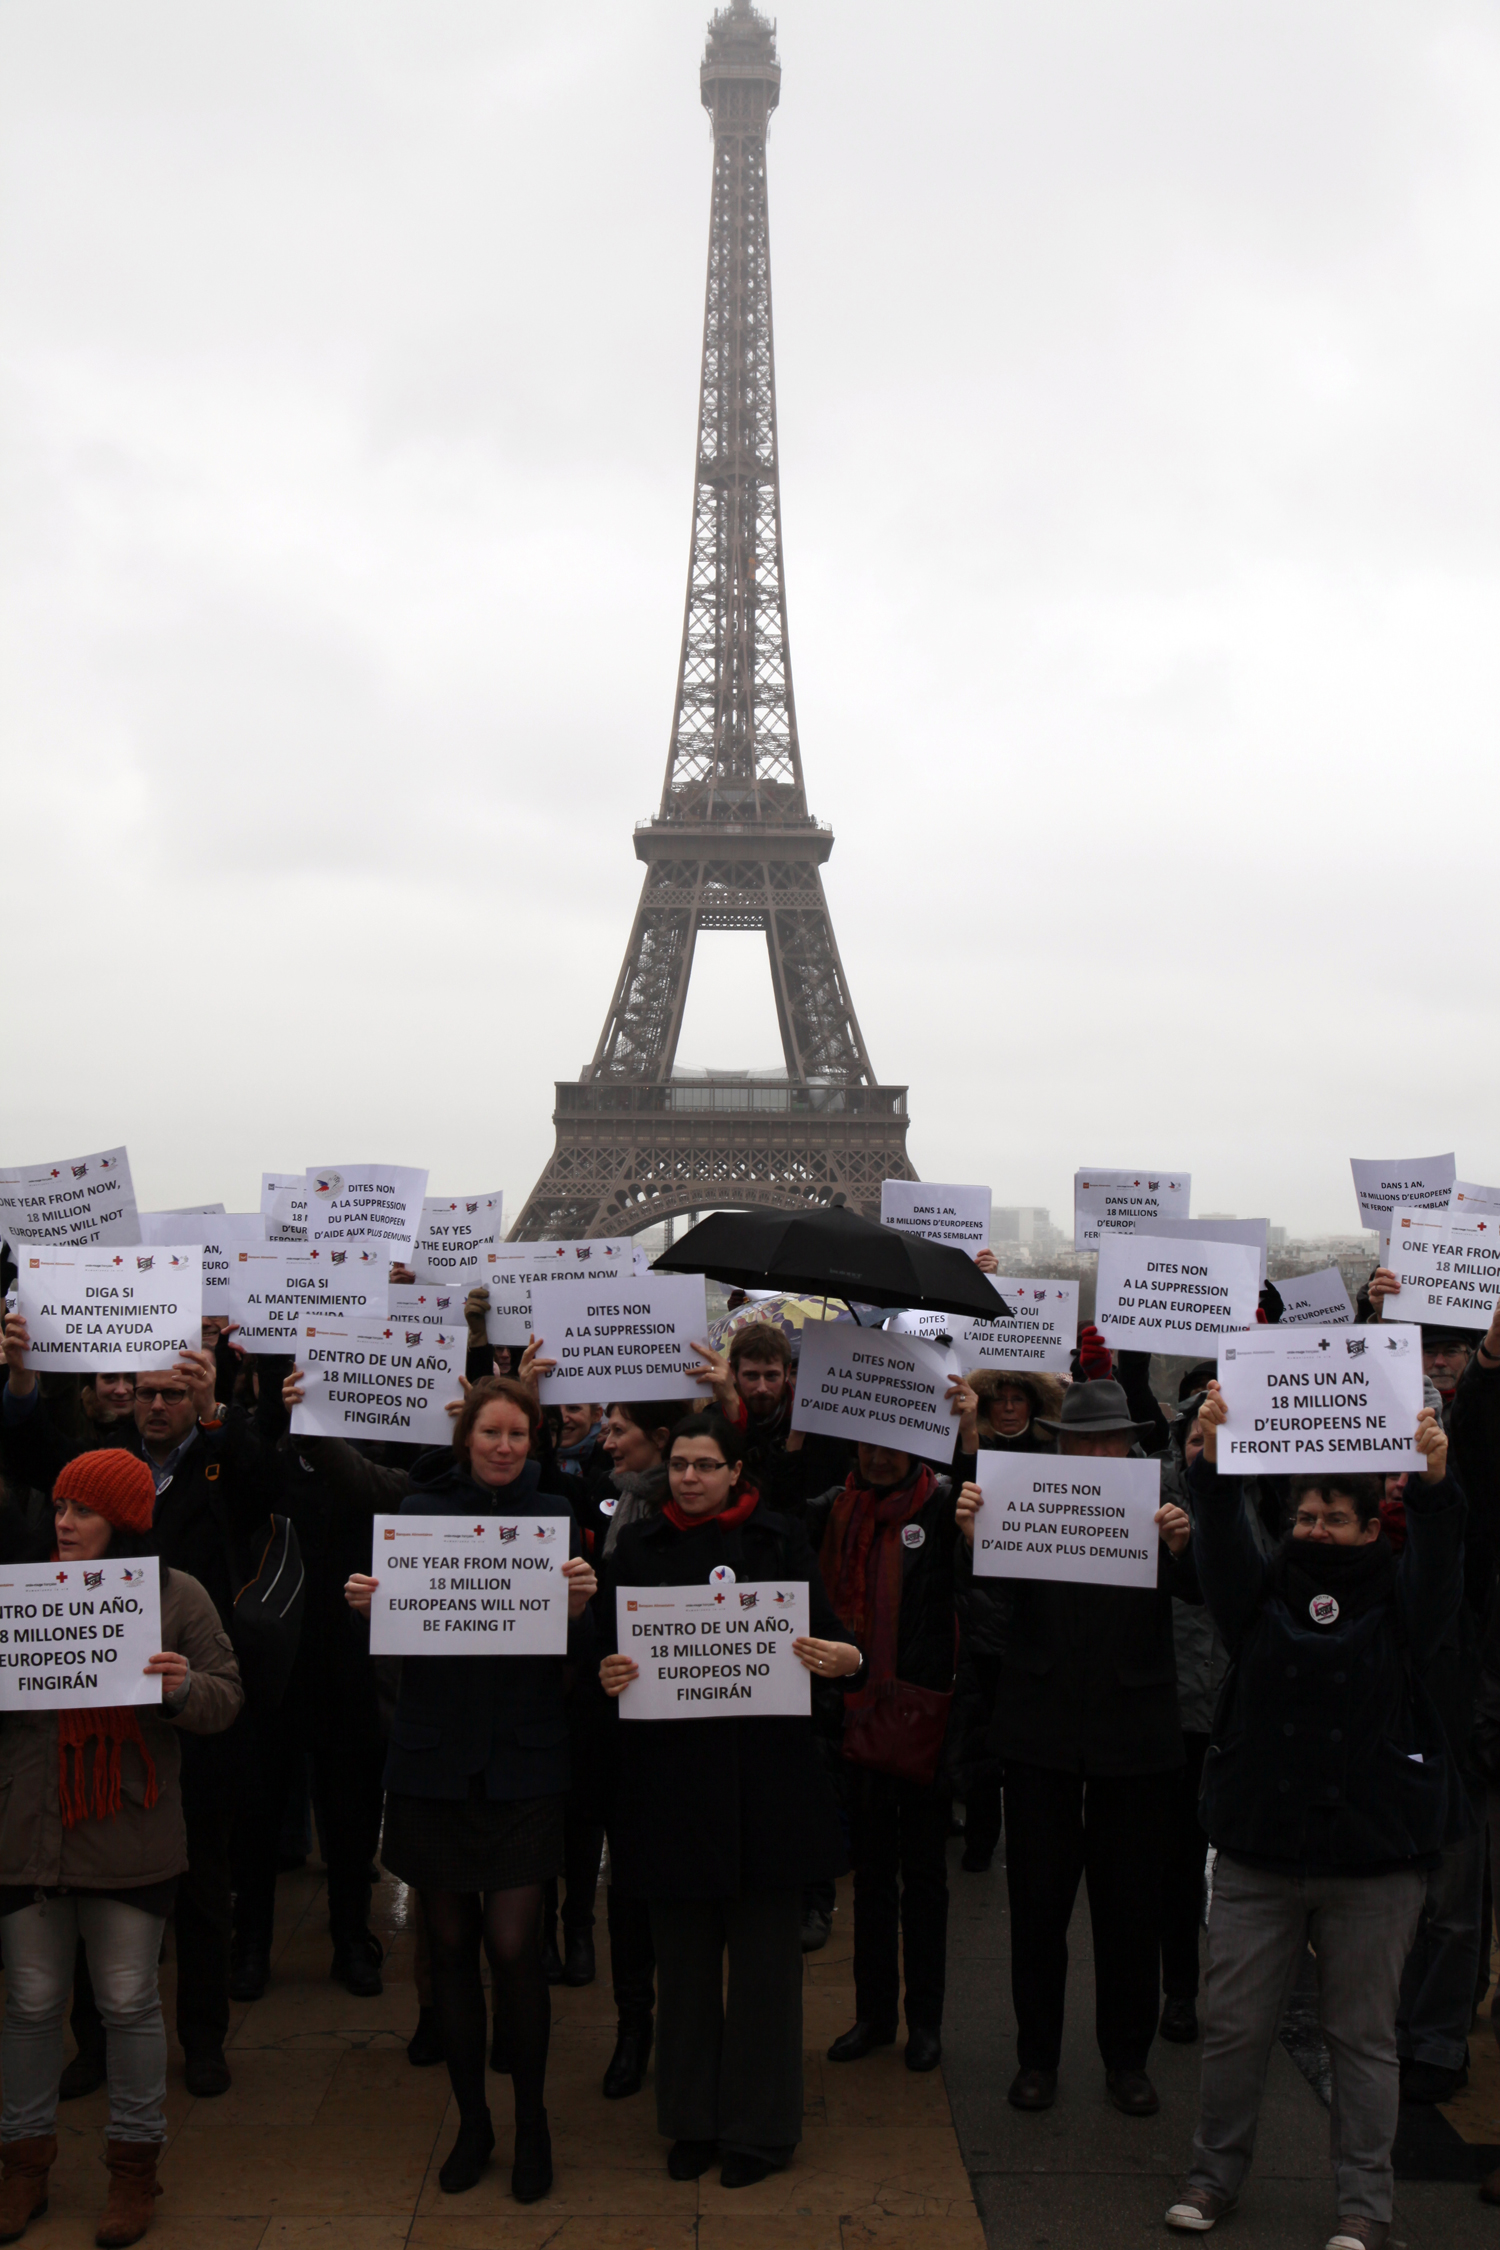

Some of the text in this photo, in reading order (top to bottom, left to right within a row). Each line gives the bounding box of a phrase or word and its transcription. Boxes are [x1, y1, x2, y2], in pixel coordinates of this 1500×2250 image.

[17, 1180, 120, 1207] YEAR FROM NOW,
[348, 1184, 395, 1194] DITES NON
[1402, 1187, 1452, 1201] D'EUROPEENS
[353, 1199, 406, 1211] SUPPRESSION
[1144, 1198, 1159, 1207] AN,
[27, 1203, 91, 1222] 18 MILLION
[328, 1213, 405, 1226] DU PLAN EUROPEEN
[1118, 1209, 1158, 1217] MILLIONS
[9, 1209, 123, 1238] EUROPEANS WILL NOT
[430, 1225, 472, 1235] SAY YES
[933, 1219, 983, 1228] D'EUROPEENS
[90, 1231, 100, 1242] IT
[314, 1228, 411, 1243] D'AIDE PLUS DEMUNIS
[421, 1241, 439, 1251] THE
[1402, 1241, 1463, 1256] ONE YEAR
[428, 1256, 478, 1267] FOOD AID
[1147, 1262, 1208, 1276] DITES NON
[1436, 1261, 1451, 1272] 18
[287, 1278, 328, 1288] DIGA SI
[492, 1273, 548, 1284] ONE YEAR
[1401, 1275, 1475, 1292] EUROPEANS
[86, 1287, 133, 1298] DIGA SI
[1123, 1279, 1228, 1297] A LA SUPPRESSION
[247, 1294, 367, 1305] AL MANTENIMIENTO
[1118, 1297, 1231, 1316] DU PLAN EUROPEEN
[1428, 1294, 1492, 1310] BE FAKING
[40, 1304, 177, 1316] AL MANTENIMIENTO
[269, 1311, 284, 1321] DE
[587, 1304, 651, 1316] DITES NON
[1020, 1307, 1039, 1316] OUI
[919, 1315, 945, 1324] DITES
[972, 1318, 1054, 1331] AU DE
[1101, 1313, 1192, 1331] D'AIDE AUX PLUS
[66, 1323, 153, 1334] DE LA AYUDA
[565, 1323, 675, 1337] A LA SUPPRESSION
[964, 1332, 1061, 1345] L'AIDE EUROPEENNE
[28, 1338, 188, 1357] ALIMENTARIA EUROPEA
[562, 1343, 681, 1358] DU PLAN EUROPEEN
[979, 1347, 1045, 1359] ALIMENTAIRE
[308, 1349, 451, 1373] DENTRO DE UN AÑO,
[852, 1352, 915, 1372] DITES NON
[587, 1364, 643, 1376] AUX PLUS
[323, 1370, 435, 1390] 18 MILLONES DE
[827, 1367, 936, 1395] A LA SUPPRESSION
[1267, 1372, 1369, 1387] DANS UN AN,
[329, 1390, 428, 1409] EUROPEOS NO
[821, 1384, 937, 1413] DU PLAN EUROPEEN
[1272, 1394, 1367, 1409] 18 MILLIONS
[344, 1410, 410, 1427] FINGIRÁN
[801, 1398, 950, 1436] D'AIDE AUX PLUS DEMUNIS
[1255, 1415, 1386, 1431] D'EUROPEENS NE
[1231, 1437, 1413, 1453] FERONT PAS SEMBLANT
[1033, 1482, 1101, 1496] DITES NON
[1007, 1501, 1125, 1518] A LA SUPPRESSION
[1002, 1521, 1129, 1539] DU PLAN EUROPEEN
[982, 1539, 1148, 1560] D'AIDE AUX PLUS DEMUNIS
[387, 1556, 553, 1572] ONE YEAR FROM NOW,
[430, 1578, 511, 1590] 18 MILLION
[42, 1596, 143, 1617] DE UN AÑO,
[389, 1599, 550, 1611] EUROPEANS WILL NOT
[423, 1619, 516, 1631] BE FAKING IT
[632, 1616, 794, 1637] DENTRO DE UN AÑO,
[14, 1624, 124, 1643] MILLONES DE
[91, 1648, 117, 1663] NO
[651, 1641, 776, 1658] 18 MILLONES DE
[658, 1663, 770, 1680] EUROPEOS NO
[19, 1671, 97, 1691] FINGIRÁN
[677, 1683, 751, 1701] FINGIRÁN
